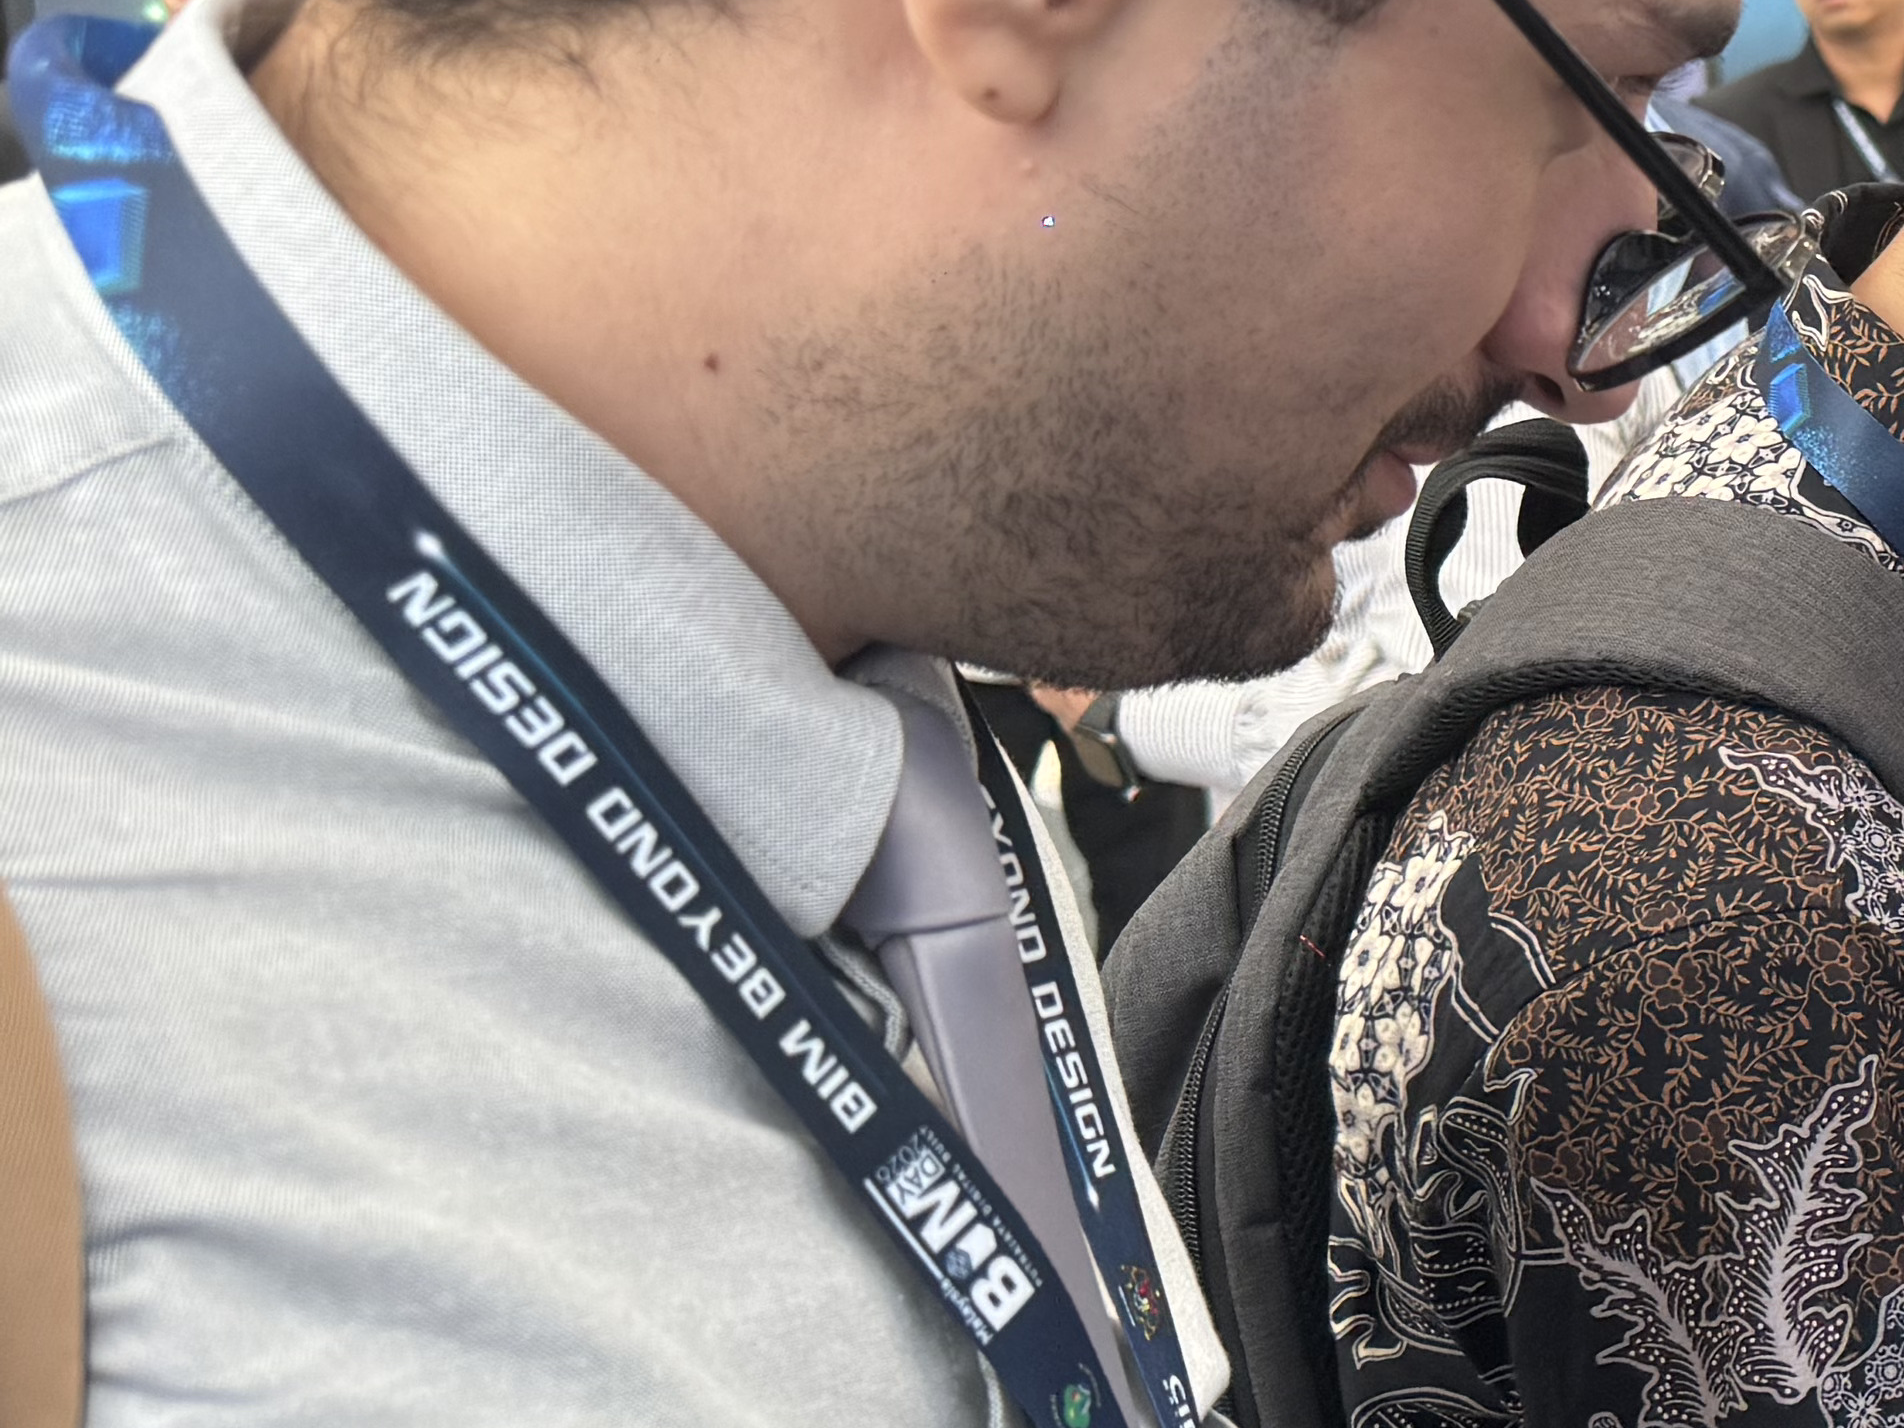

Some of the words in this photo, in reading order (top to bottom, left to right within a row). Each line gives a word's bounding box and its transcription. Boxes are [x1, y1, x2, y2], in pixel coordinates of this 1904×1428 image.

[388, 571, 598, 786] DESIGN
[585, 787, 785, 1021] BEYOND
[779, 1018, 878, 1134] BIM
[1031, 981, 1117, 1179] DESIGN
[951, 1162, 993, 1216] DIGITAL
[936, 1275, 994, 1345] Malaysia
